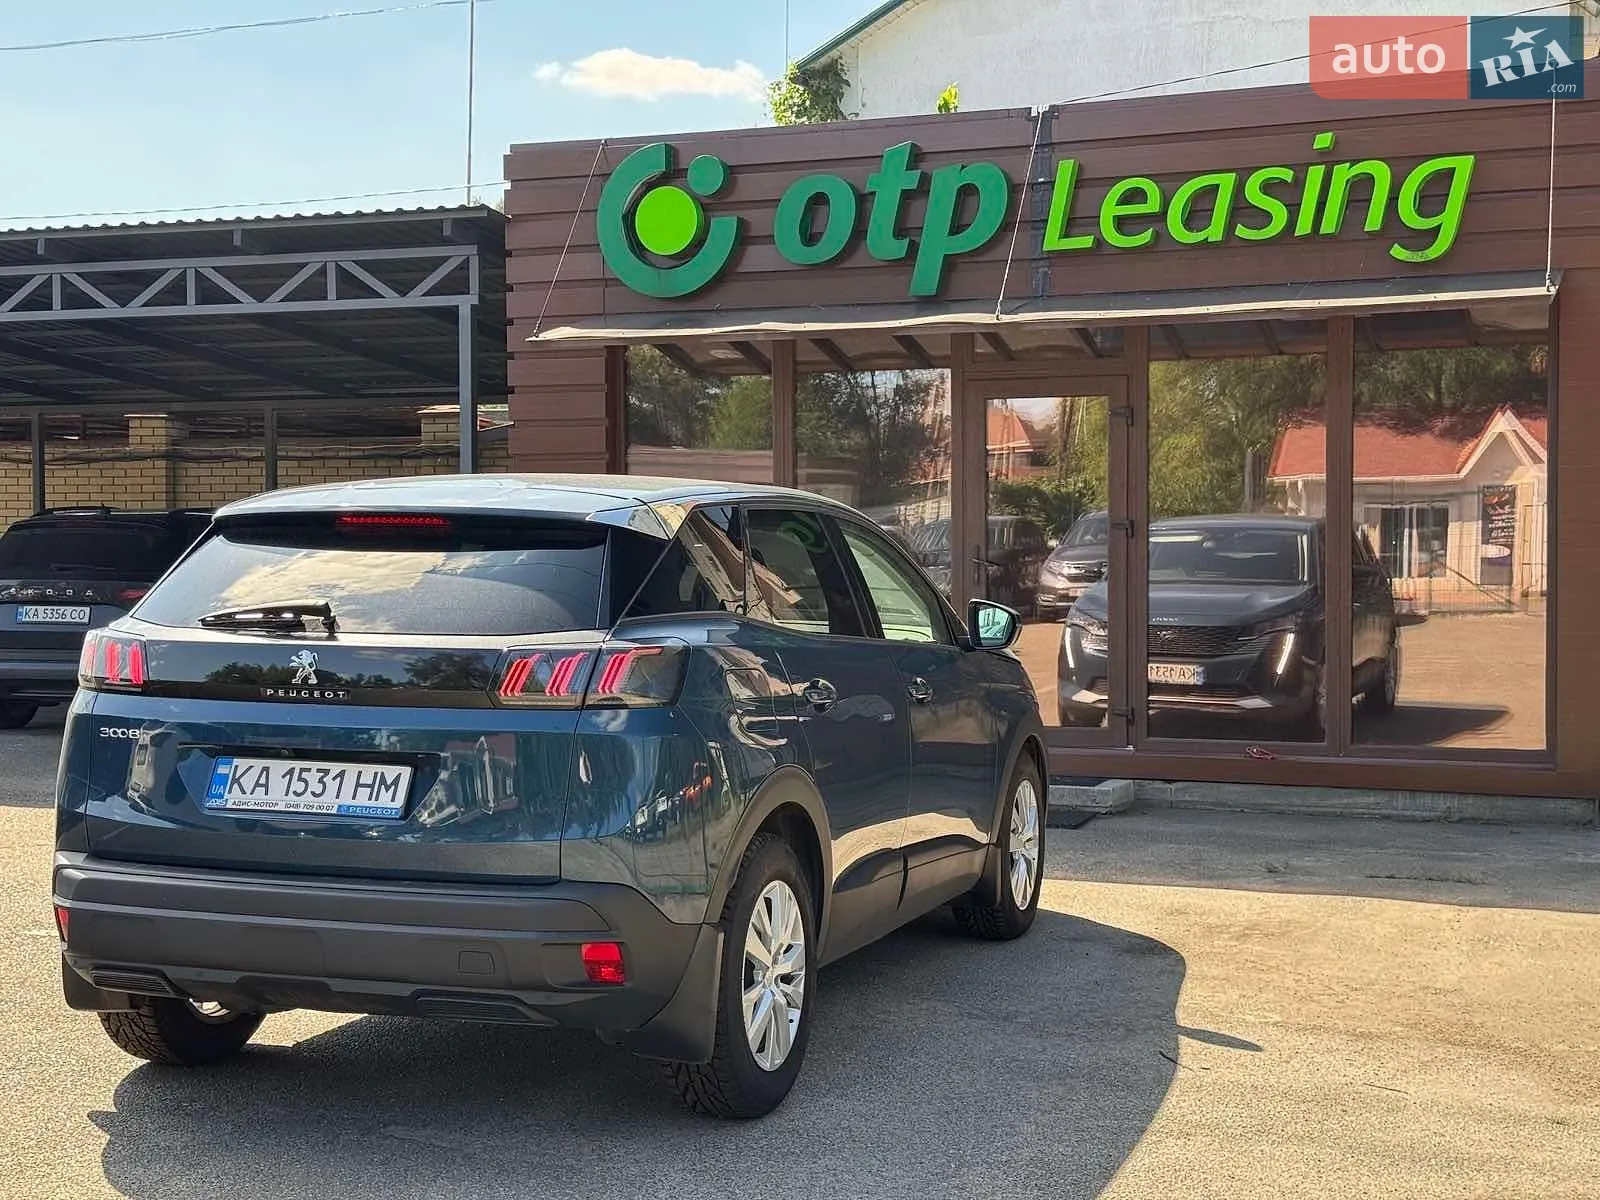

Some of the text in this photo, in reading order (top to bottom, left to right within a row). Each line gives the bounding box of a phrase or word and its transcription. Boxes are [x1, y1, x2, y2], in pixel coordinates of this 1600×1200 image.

[774, 131, 1477, 296] otp Leasing
[24, 607, 86, 620] KA 5356 CO
[266, 688, 346, 699] PEUGEOT
[99, 727, 140, 739] 3008
[227, 764, 402, 803] KA 1531 HM
[211, 784, 225, 796] UA
[231, 800, 279, 809] АДИС-МОТОР
[349, 806, 398, 816] PEUGEOT
